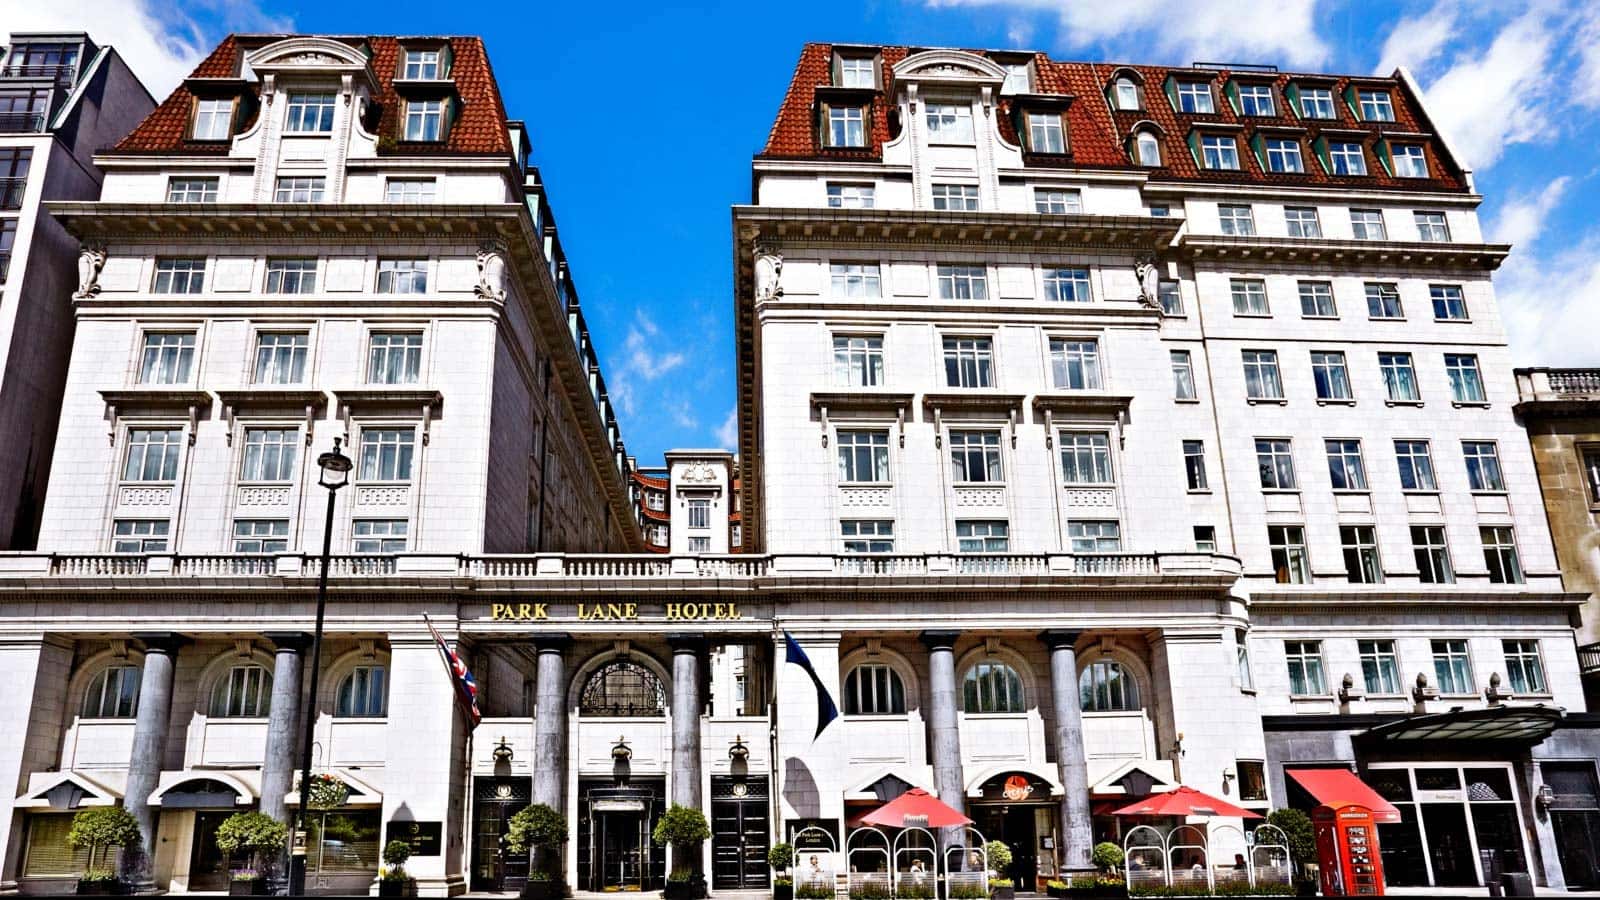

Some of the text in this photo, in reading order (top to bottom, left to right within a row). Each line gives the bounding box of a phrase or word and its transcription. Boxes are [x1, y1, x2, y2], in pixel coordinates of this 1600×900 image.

[491, 602, 741, 619] PARK LANE HOTEL
